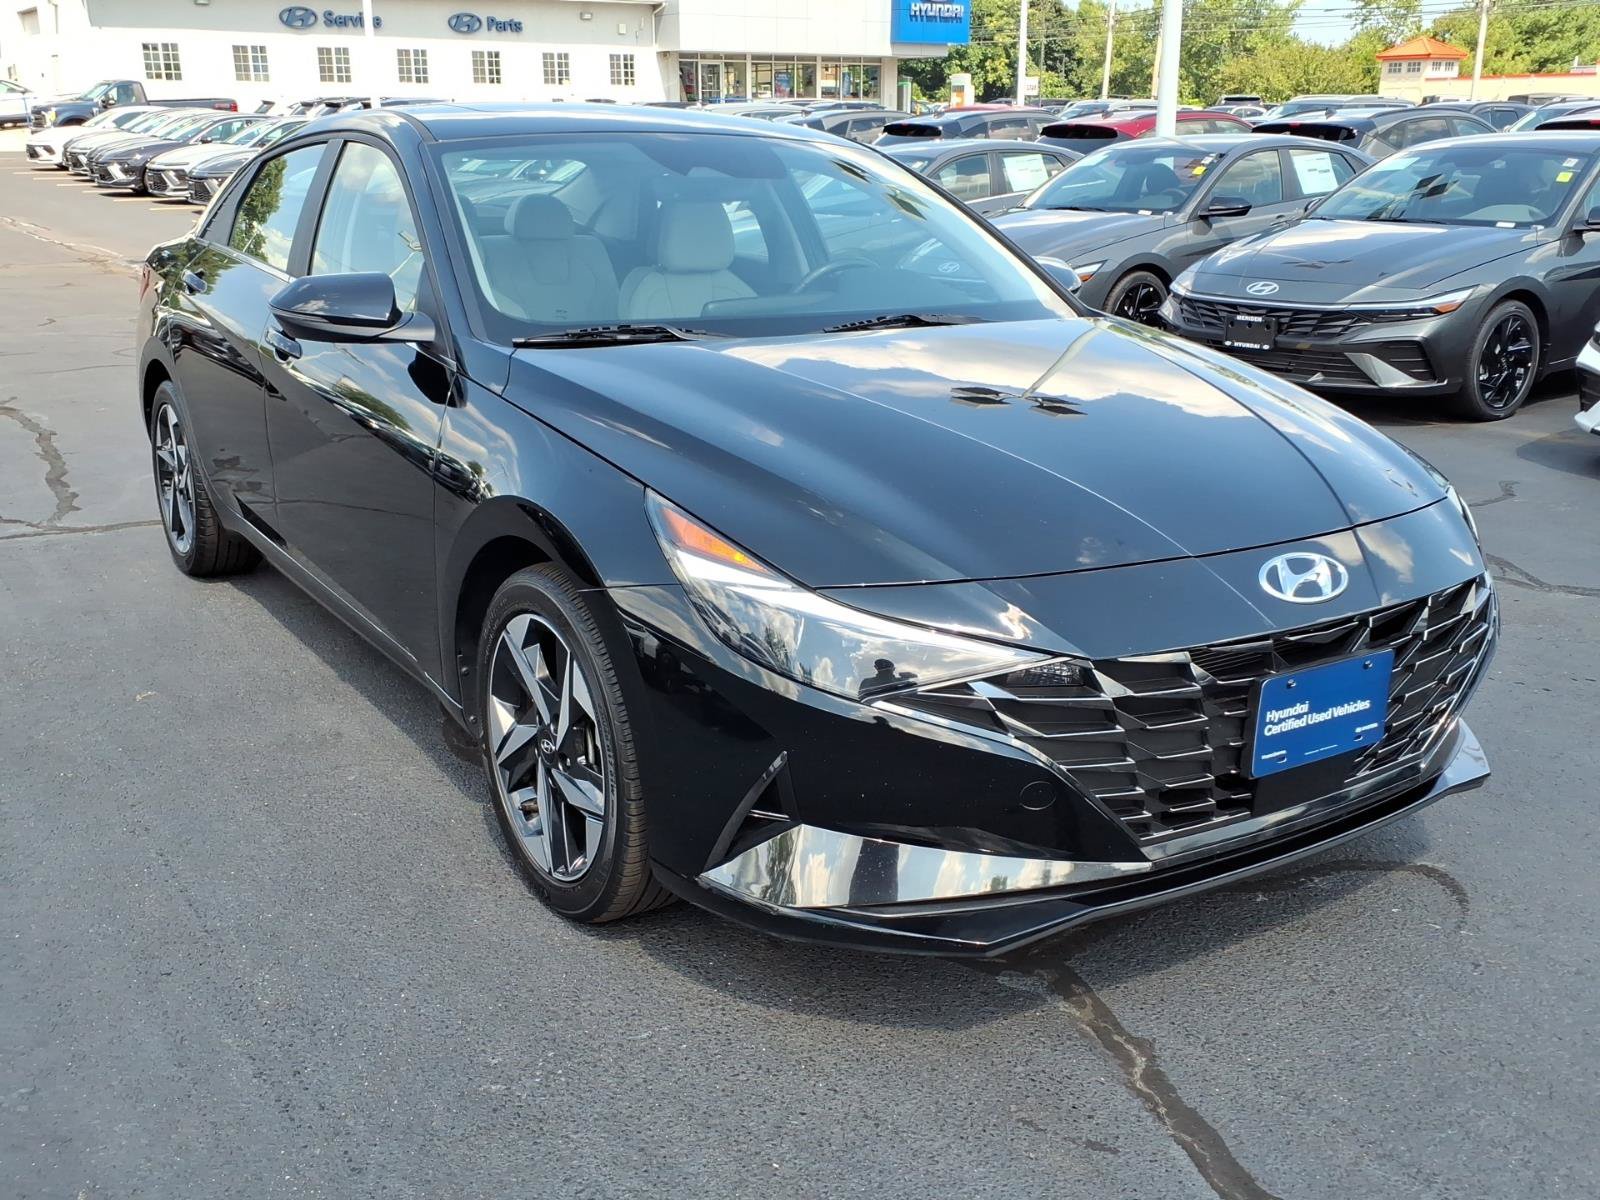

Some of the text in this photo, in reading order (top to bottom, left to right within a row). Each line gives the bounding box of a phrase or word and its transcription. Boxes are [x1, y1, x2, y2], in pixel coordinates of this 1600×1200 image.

[323, 9, 382, 28] Servie
[911, 2, 965, 18] HYUNDAI
[486, 16, 523, 33] Parts
[1234, 341, 1261, 349] HYUNDAI
[1264, 699, 1371, 736] Certified Used Vehicles
[1266, 701, 1309, 722] Hyundai
